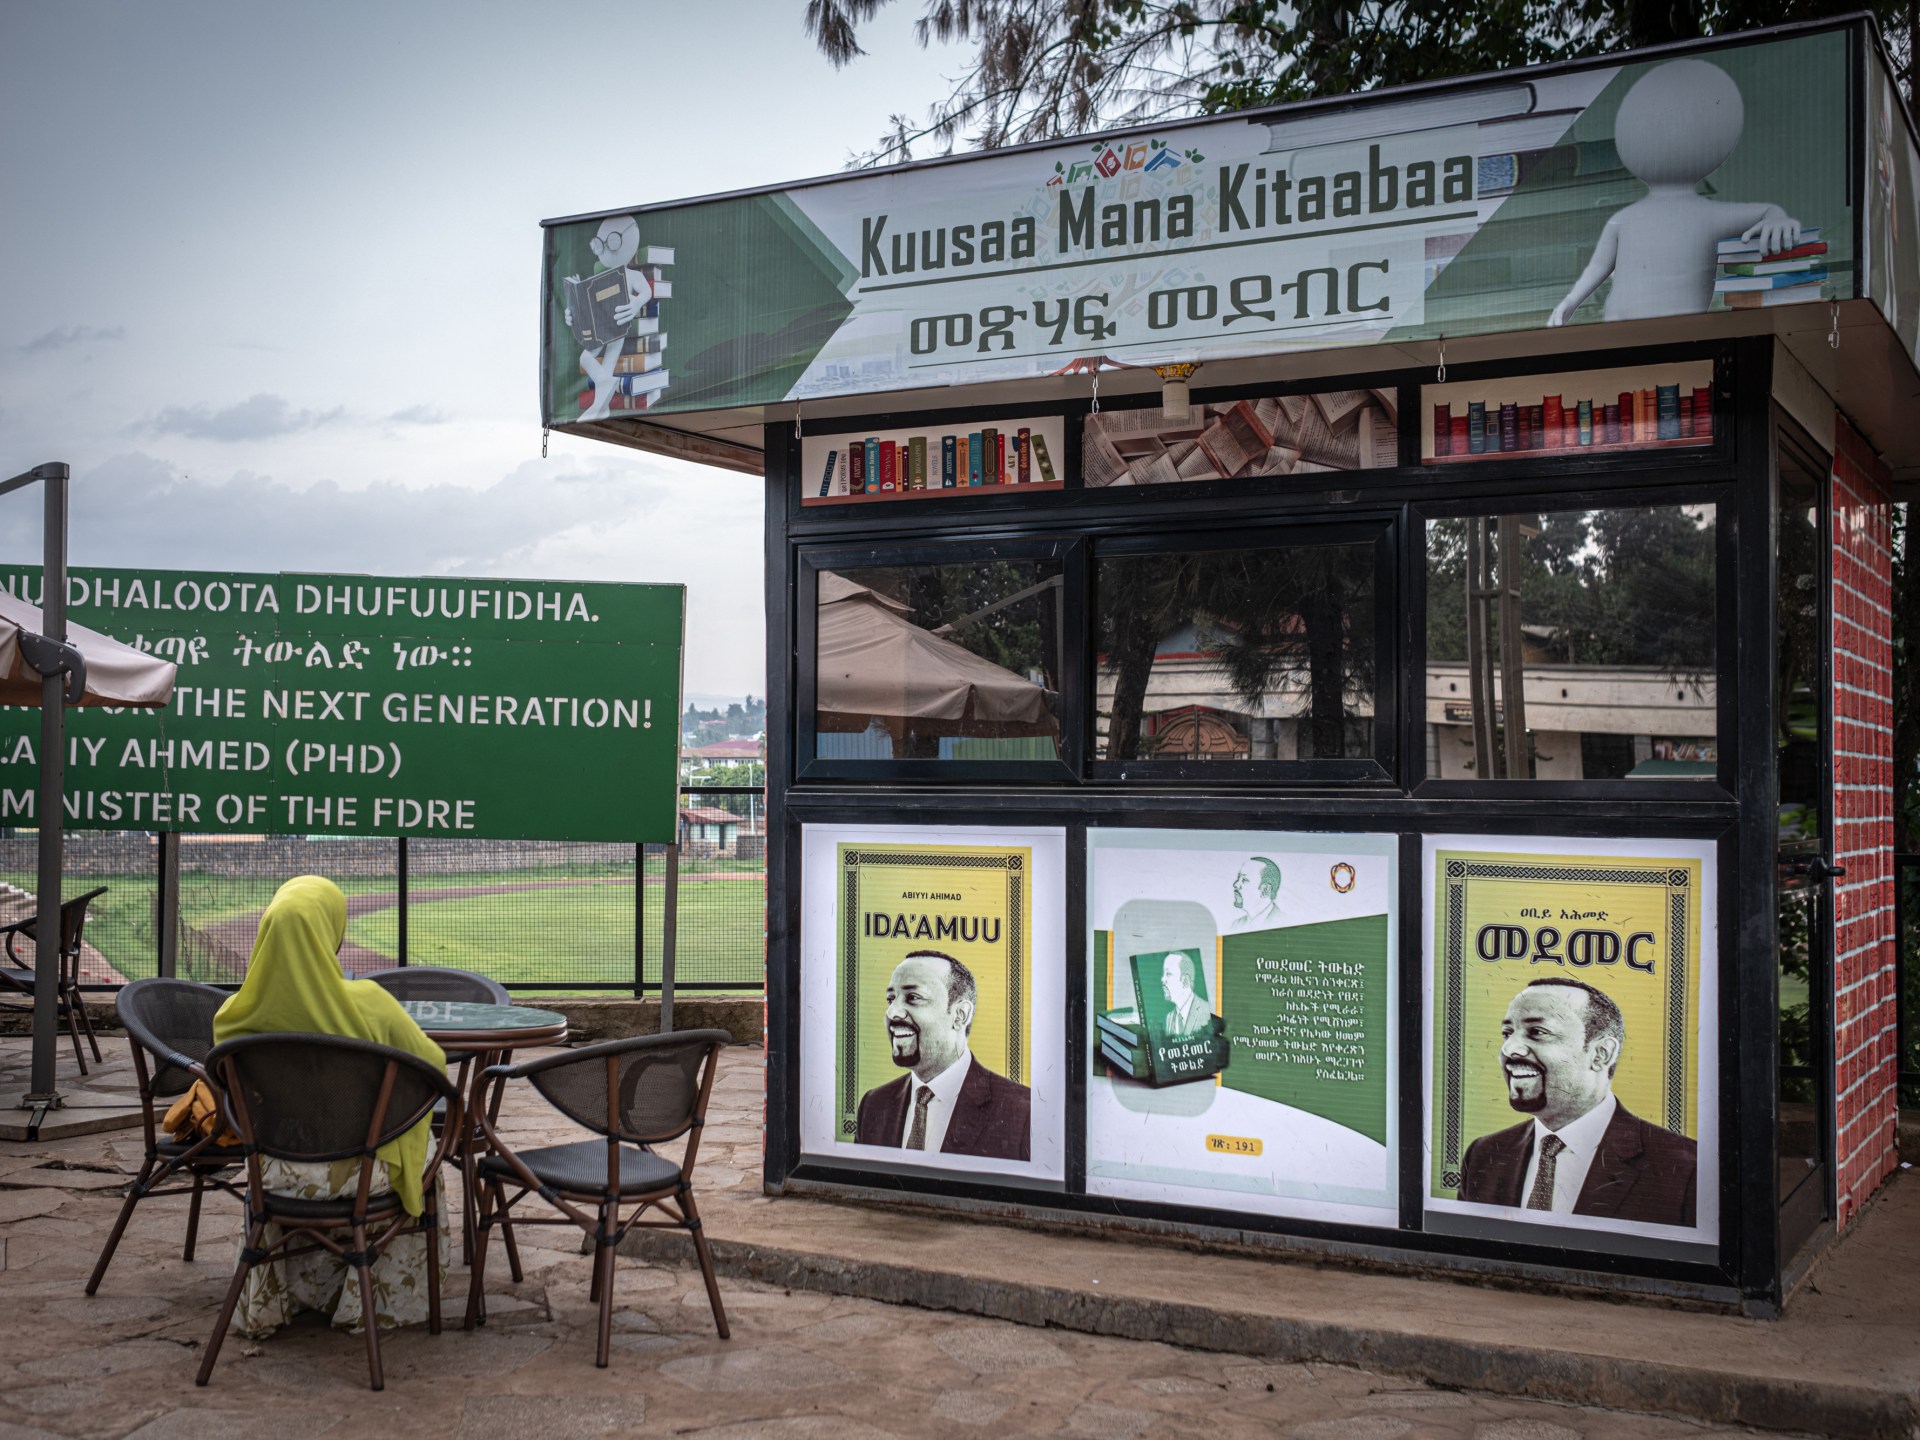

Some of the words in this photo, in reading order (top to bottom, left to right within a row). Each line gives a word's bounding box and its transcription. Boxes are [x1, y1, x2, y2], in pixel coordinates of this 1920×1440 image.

[861, 213, 1036, 279] Kuusaa
[1059, 185, 1195, 256] Mana
[1219, 144, 1474, 233] Kitaabaa
[910, 292, 1117, 355] መጽሃፍ
[1147, 258, 1391, 331] መደብር
[1007, 454, 1016, 470] ART
[66, 576, 281, 614] DHALOOTA
[296, 584, 601, 623] DHUFUUFIDHA.
[107, 633, 210, 665] ቀጣዩ
[233, 634, 371, 669] ትውልድ
[173, 686, 247, 718] THE
[262, 690, 371, 721] NEXT
[382, 692, 653, 729] GENERATION!
[119, 738, 270, 771] AHMED
[285, 738, 402, 779] (PHD)
[2, 788, 201, 823] MNISTER
[215, 793, 268, 824] OF
[280, 796, 358, 827] THE
[373, 798, 476, 829] FDRE
[902, 891, 928, 901] ABIYYI
[930, 892, 962, 901] AHIMAD
[864, 911, 1001, 944] IDA'AMUU
[1256, 957, 1313, 973] የመደመር
[1318, 960, 1365, 976] ትውልድ
[1475, 923, 1656, 975] መደመር
[1158, 1040, 1213, 1062] የመደመር
[1170, 1057, 1205, 1073] ትውልድ
[1235, 1141, 1255, 1152] 191
